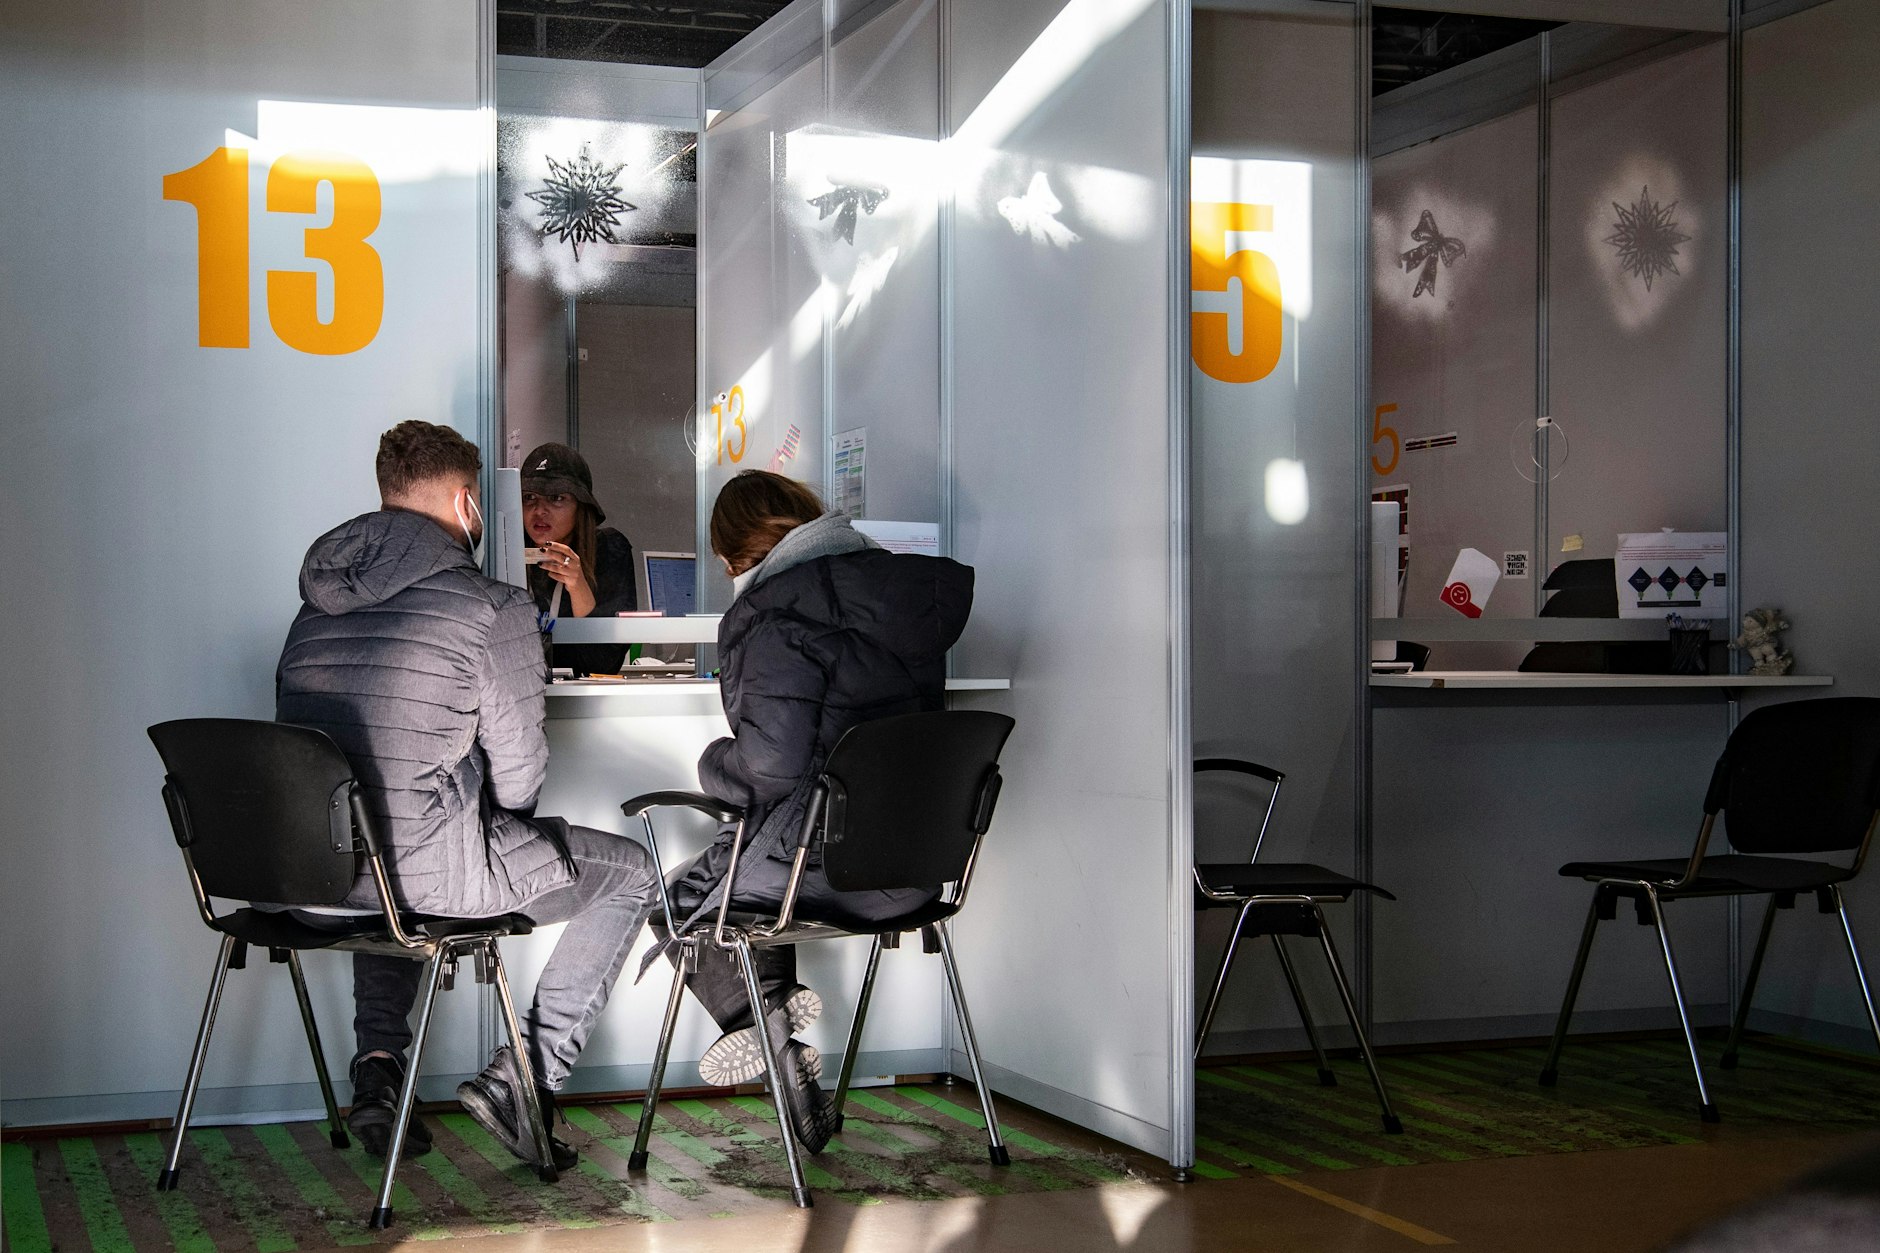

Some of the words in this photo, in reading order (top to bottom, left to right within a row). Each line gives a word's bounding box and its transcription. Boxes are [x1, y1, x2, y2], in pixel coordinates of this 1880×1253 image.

[163, 147, 384, 355] 13
[1191, 202, 1283, 383] 5
[710, 384, 747, 466] 13
[1372, 403, 1399, 475] 5
